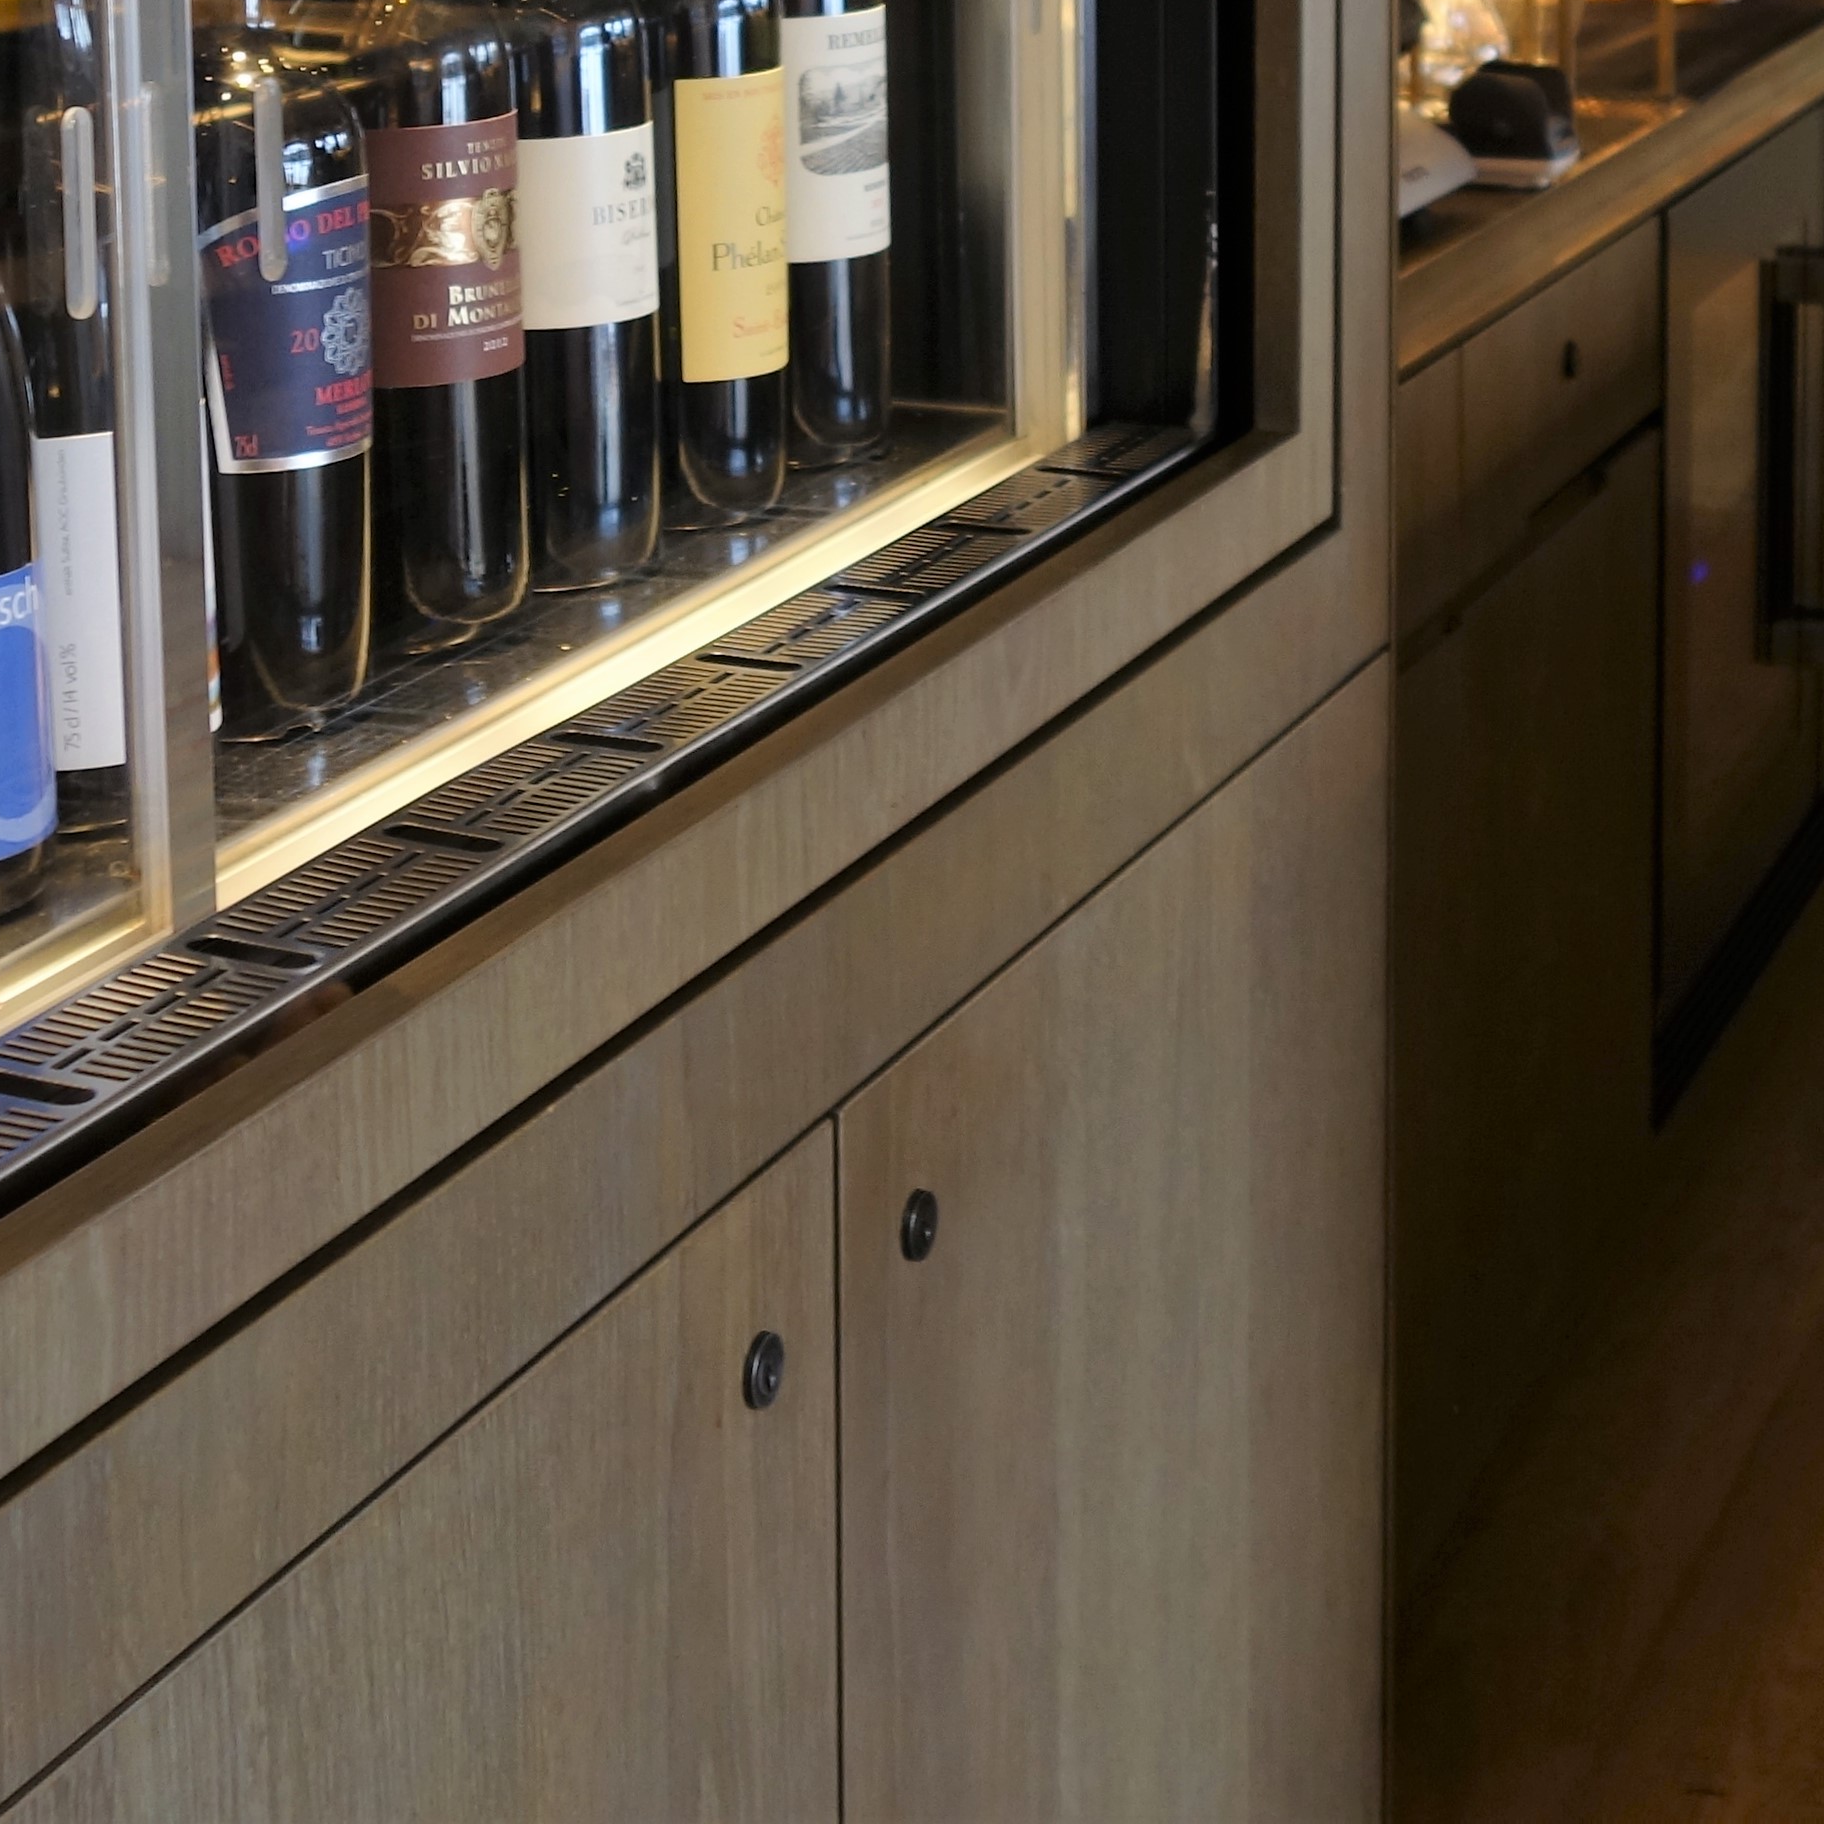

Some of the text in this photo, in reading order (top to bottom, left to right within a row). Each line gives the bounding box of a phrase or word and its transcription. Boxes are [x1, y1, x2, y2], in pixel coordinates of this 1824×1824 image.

[421, 156, 492, 180] SILVIO
[316, 206, 354, 234] DEL
[63, 717, 81, 729] cl
[63, 732, 81, 752] 75
